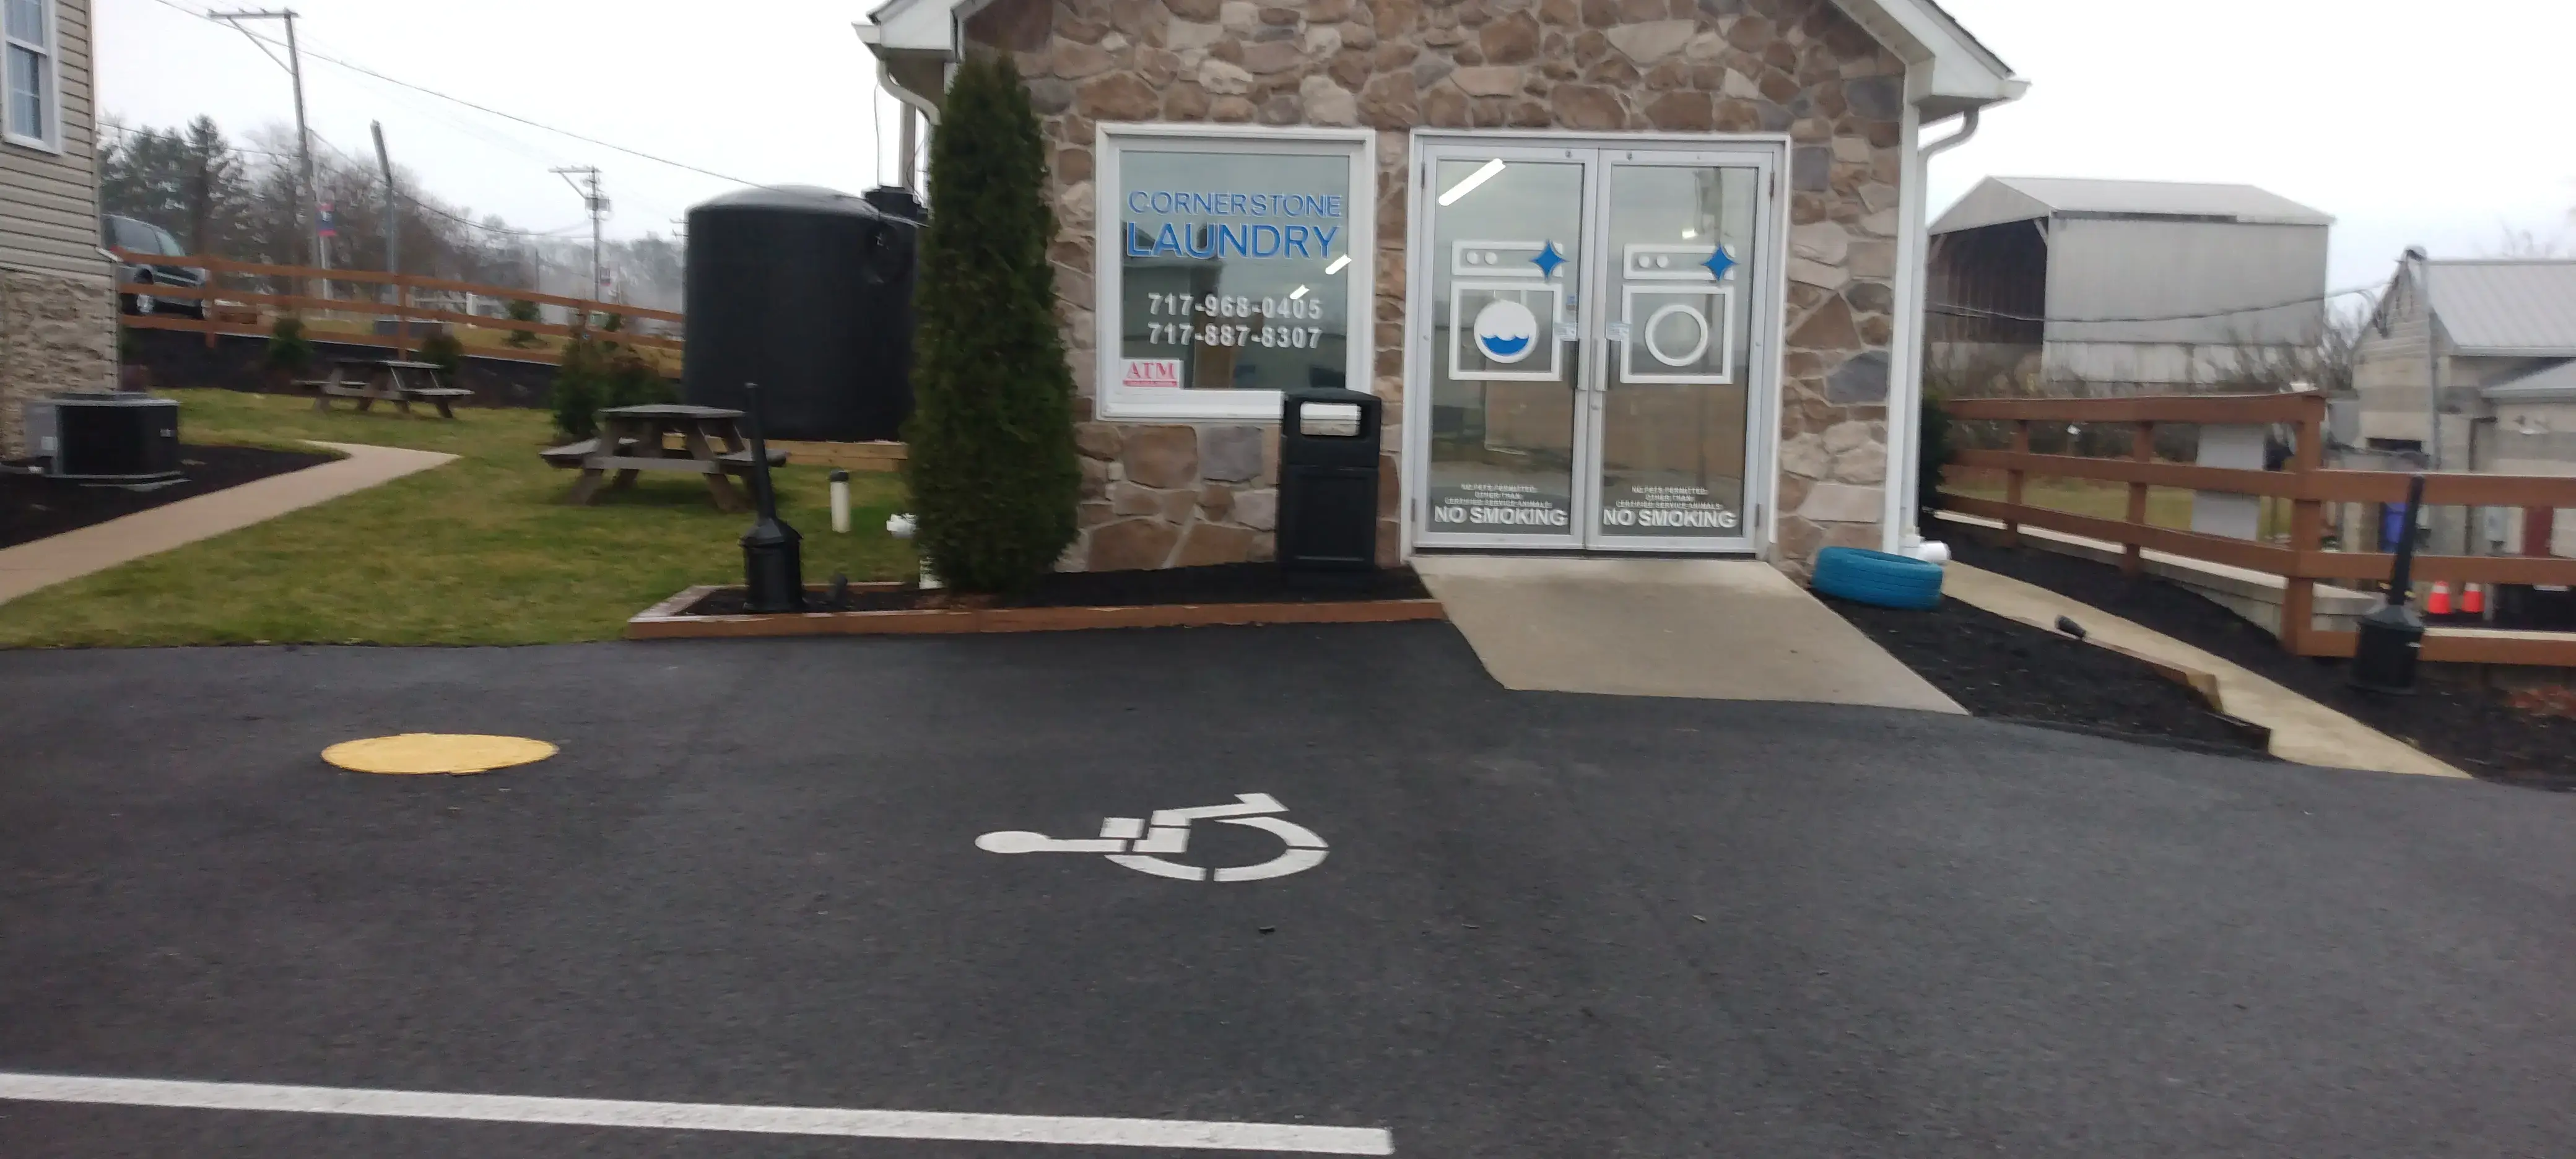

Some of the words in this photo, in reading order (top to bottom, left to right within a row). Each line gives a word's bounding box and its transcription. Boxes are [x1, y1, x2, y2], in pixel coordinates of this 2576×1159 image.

[1128, 191, 1342, 218] CORNERSTONE
[1126, 220, 1341, 259] LAUNDRY
[1148, 292, 1323, 319] 717-968-0405
[1147, 321, 1323, 349] 717-887-8307
[1126, 362, 1176, 380] ATM
[1434, 506, 1467, 523] NO
[1469, 506, 1568, 526] SMOKING
[1603, 508, 1636, 526] NO
[1638, 508, 1737, 528] SMOKING
